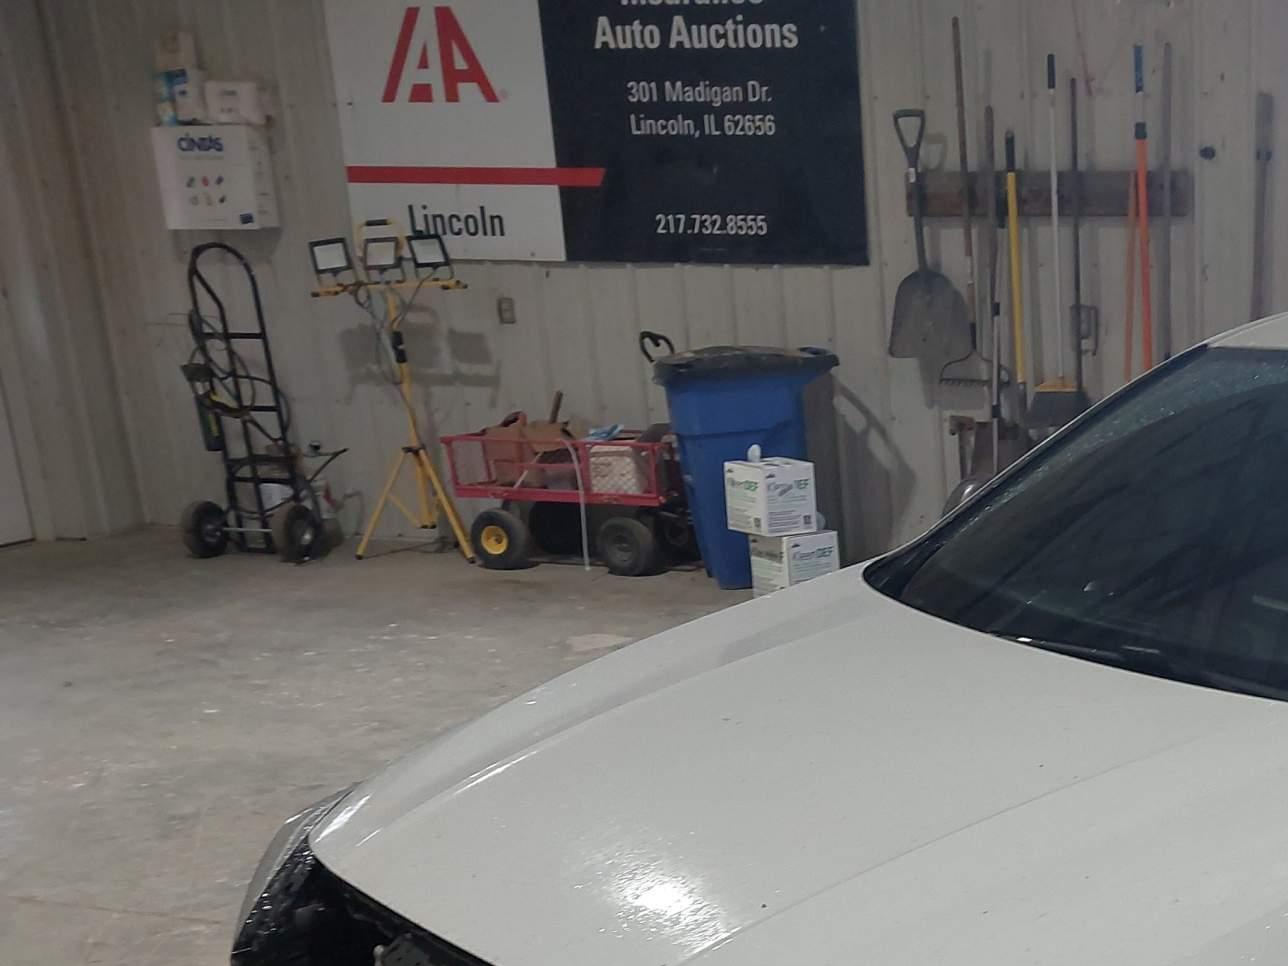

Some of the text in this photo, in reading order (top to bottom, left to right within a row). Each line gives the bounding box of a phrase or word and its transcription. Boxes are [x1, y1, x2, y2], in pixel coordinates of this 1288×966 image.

[594, 14, 799, 49] Auto Auctions
[627, 80, 772, 107] 301 Madigan Dr.
[630, 114, 776, 138] Lincoln, IL 62656
[407, 204, 506, 237] Lincoln
[655, 213, 768, 236] 217.732.8555
